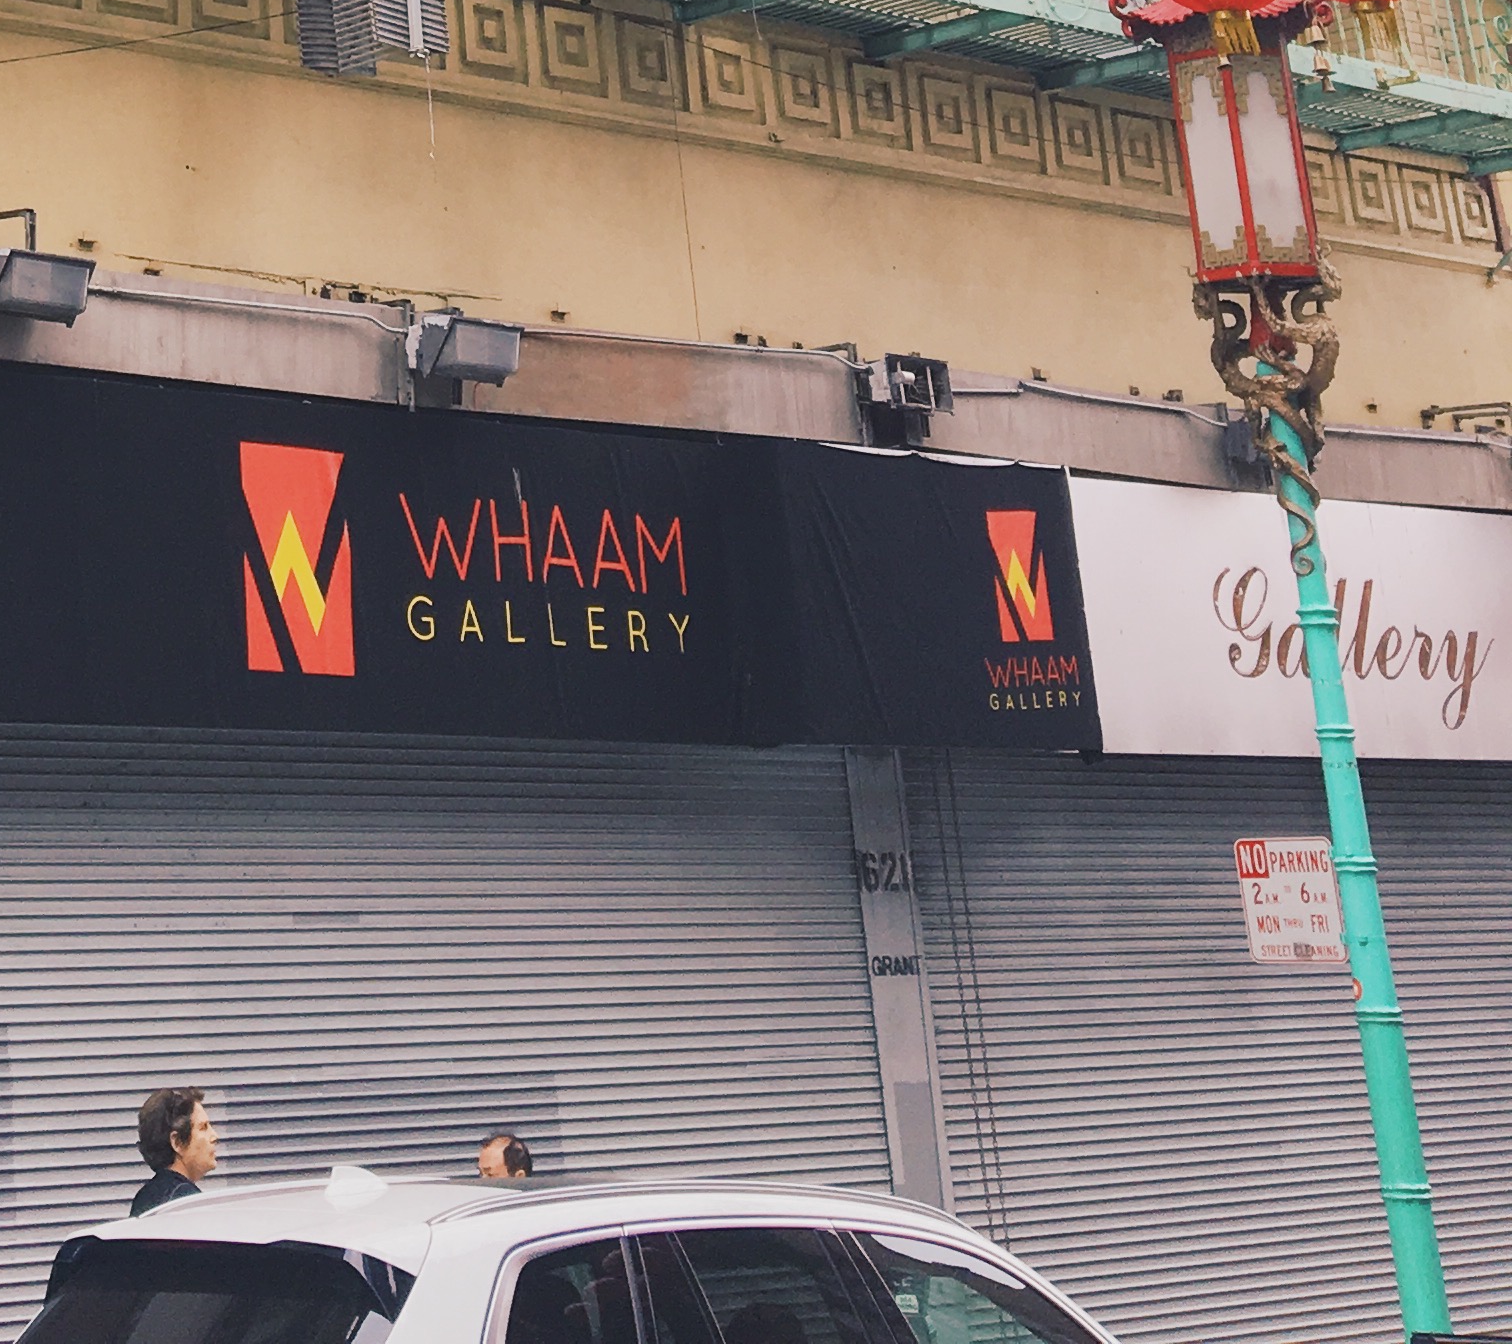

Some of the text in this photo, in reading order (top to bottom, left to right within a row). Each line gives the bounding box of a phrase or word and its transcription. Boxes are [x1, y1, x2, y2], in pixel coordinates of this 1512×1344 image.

[399, 492, 688, 596] WHAAM
[407, 595, 691, 654] GALLERY
[984, 655, 1080, 689] WHAAM
[989, 690, 1081, 711] GALLERY
[861, 851, 914, 893] 621
[1239, 843, 1329, 875] NO PARKING
[1251, 882, 1264, 905] 2
[1300, 882, 1311, 905] 6
[1256, 914, 1330, 934] MON THRU FRI
[1261, 943, 1293, 959] STREET
[871, 954, 923, 977] GRANT
